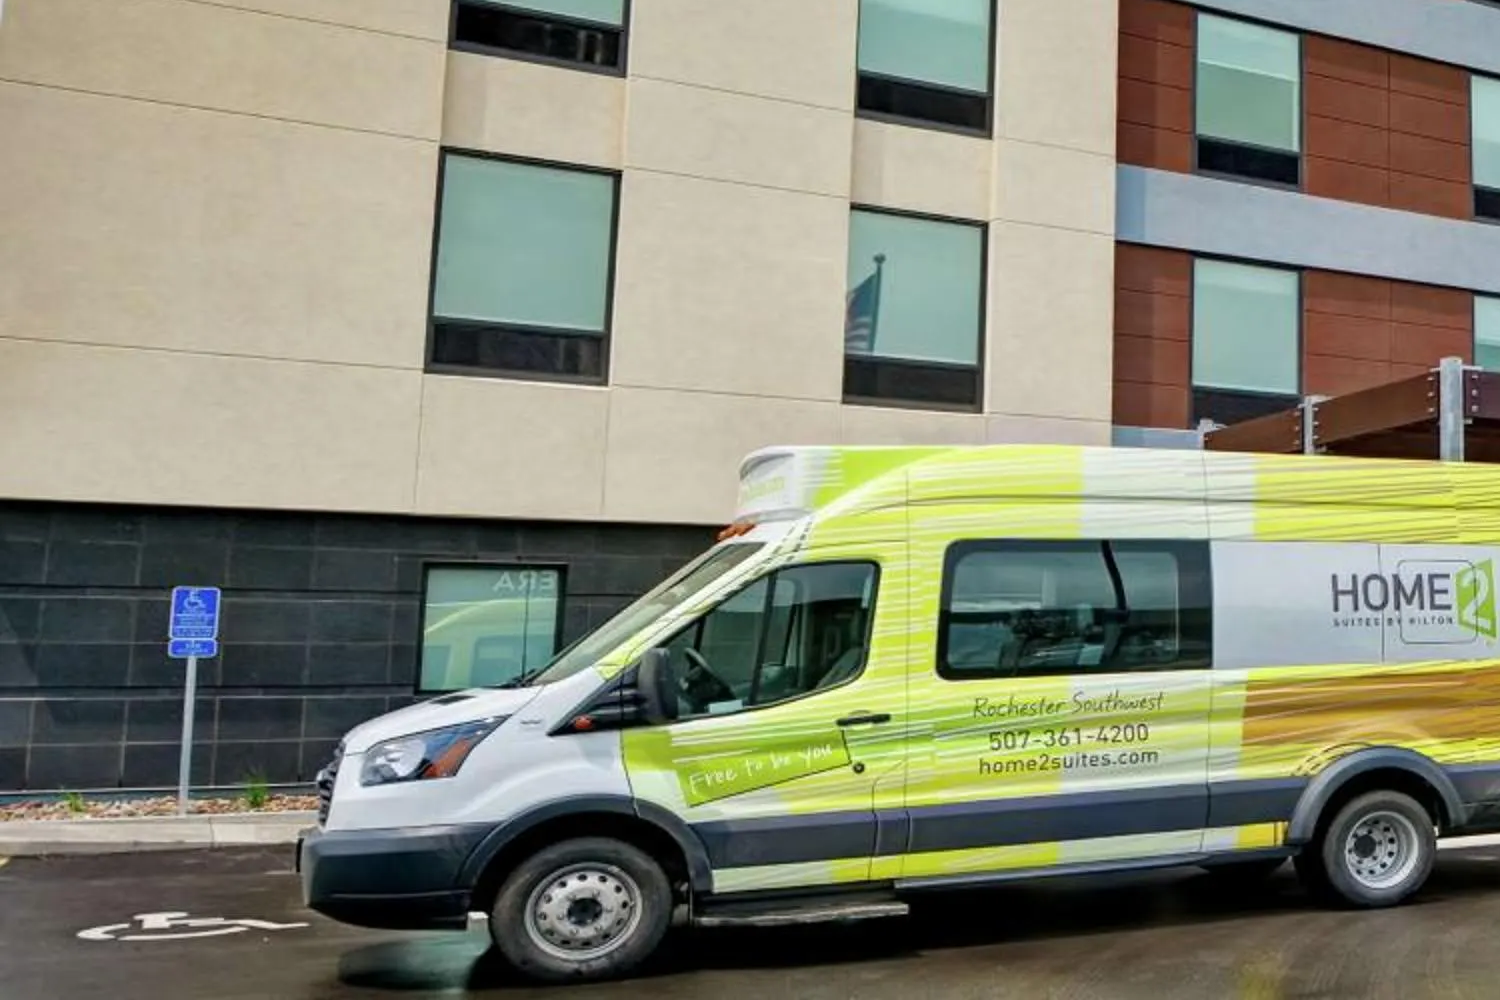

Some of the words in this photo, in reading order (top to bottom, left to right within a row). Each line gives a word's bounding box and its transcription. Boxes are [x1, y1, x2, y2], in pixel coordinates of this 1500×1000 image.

[1331, 573, 1453, 612] HOME
[1457, 568, 1491, 630] 2
[1333, 616, 1381, 628] SUITES
[1408, 614, 1454, 626] HILTON
[973, 693, 1066, 719] Rochester
[1071, 688, 1165, 715] Southwest
[988, 722, 1150, 751] 507-361-4200
[689, 768, 738, 796] Free
[797, 743, 833, 768] you
[978, 750, 1159, 776] home2suites.com
